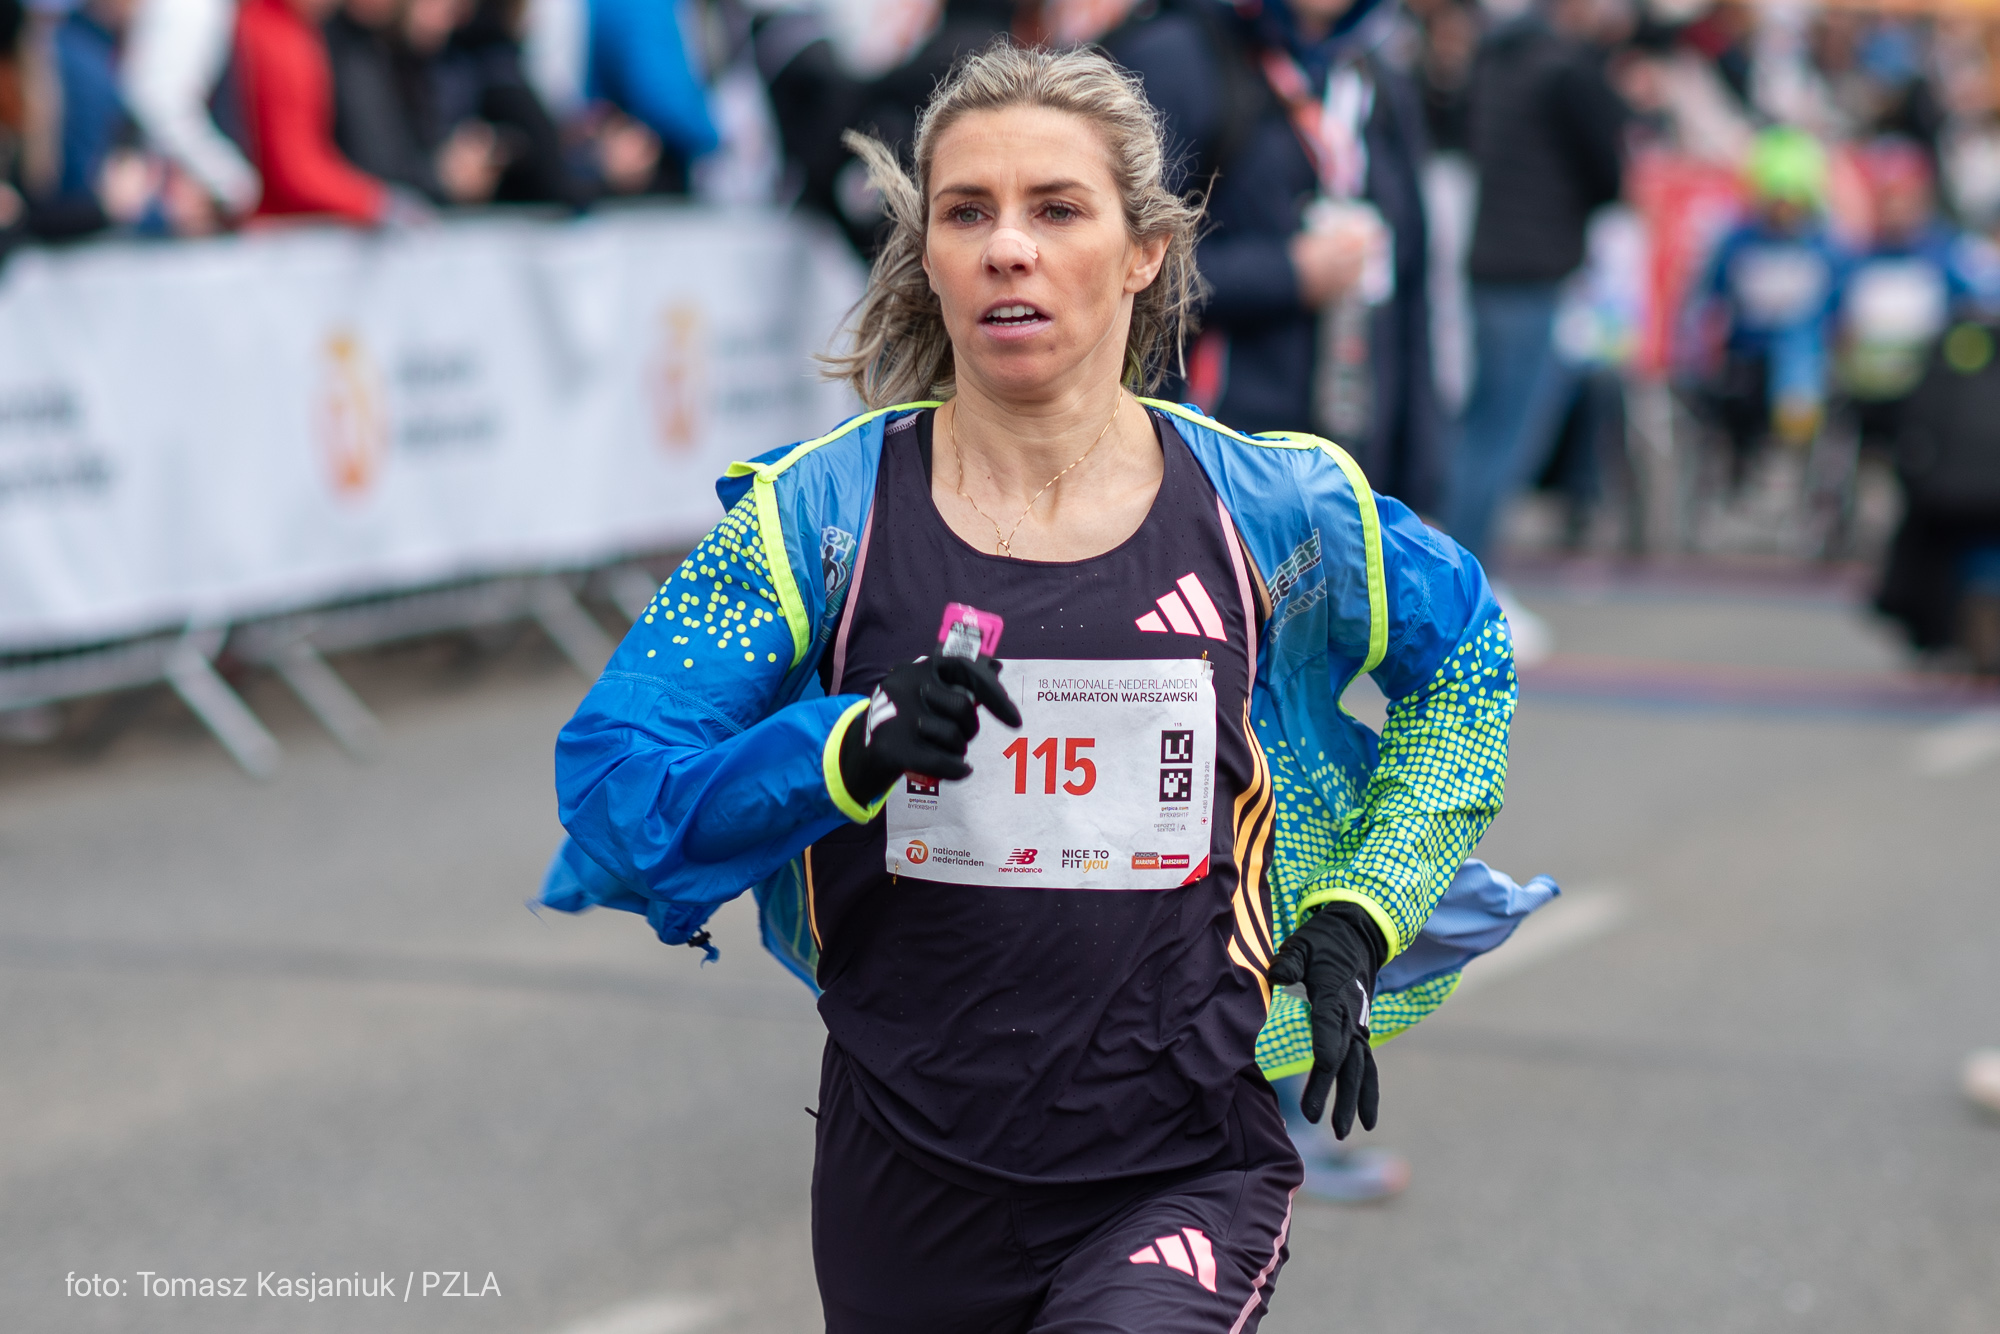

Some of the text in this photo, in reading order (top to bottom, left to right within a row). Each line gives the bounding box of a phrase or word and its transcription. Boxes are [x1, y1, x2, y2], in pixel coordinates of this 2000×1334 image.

[1038, 678, 1198, 690] 18. NATIONALE-NEDERLANDEN
[1037, 690, 1198, 703] PÓŁMARATON WARSZAWSKI
[1002, 737, 1097, 796] 115
[932, 846, 971, 858] nationale
[1061, 849, 1110, 859] NICE TO
[932, 855, 985, 867] nederlanden
[1061, 859, 1082, 868] FIT
